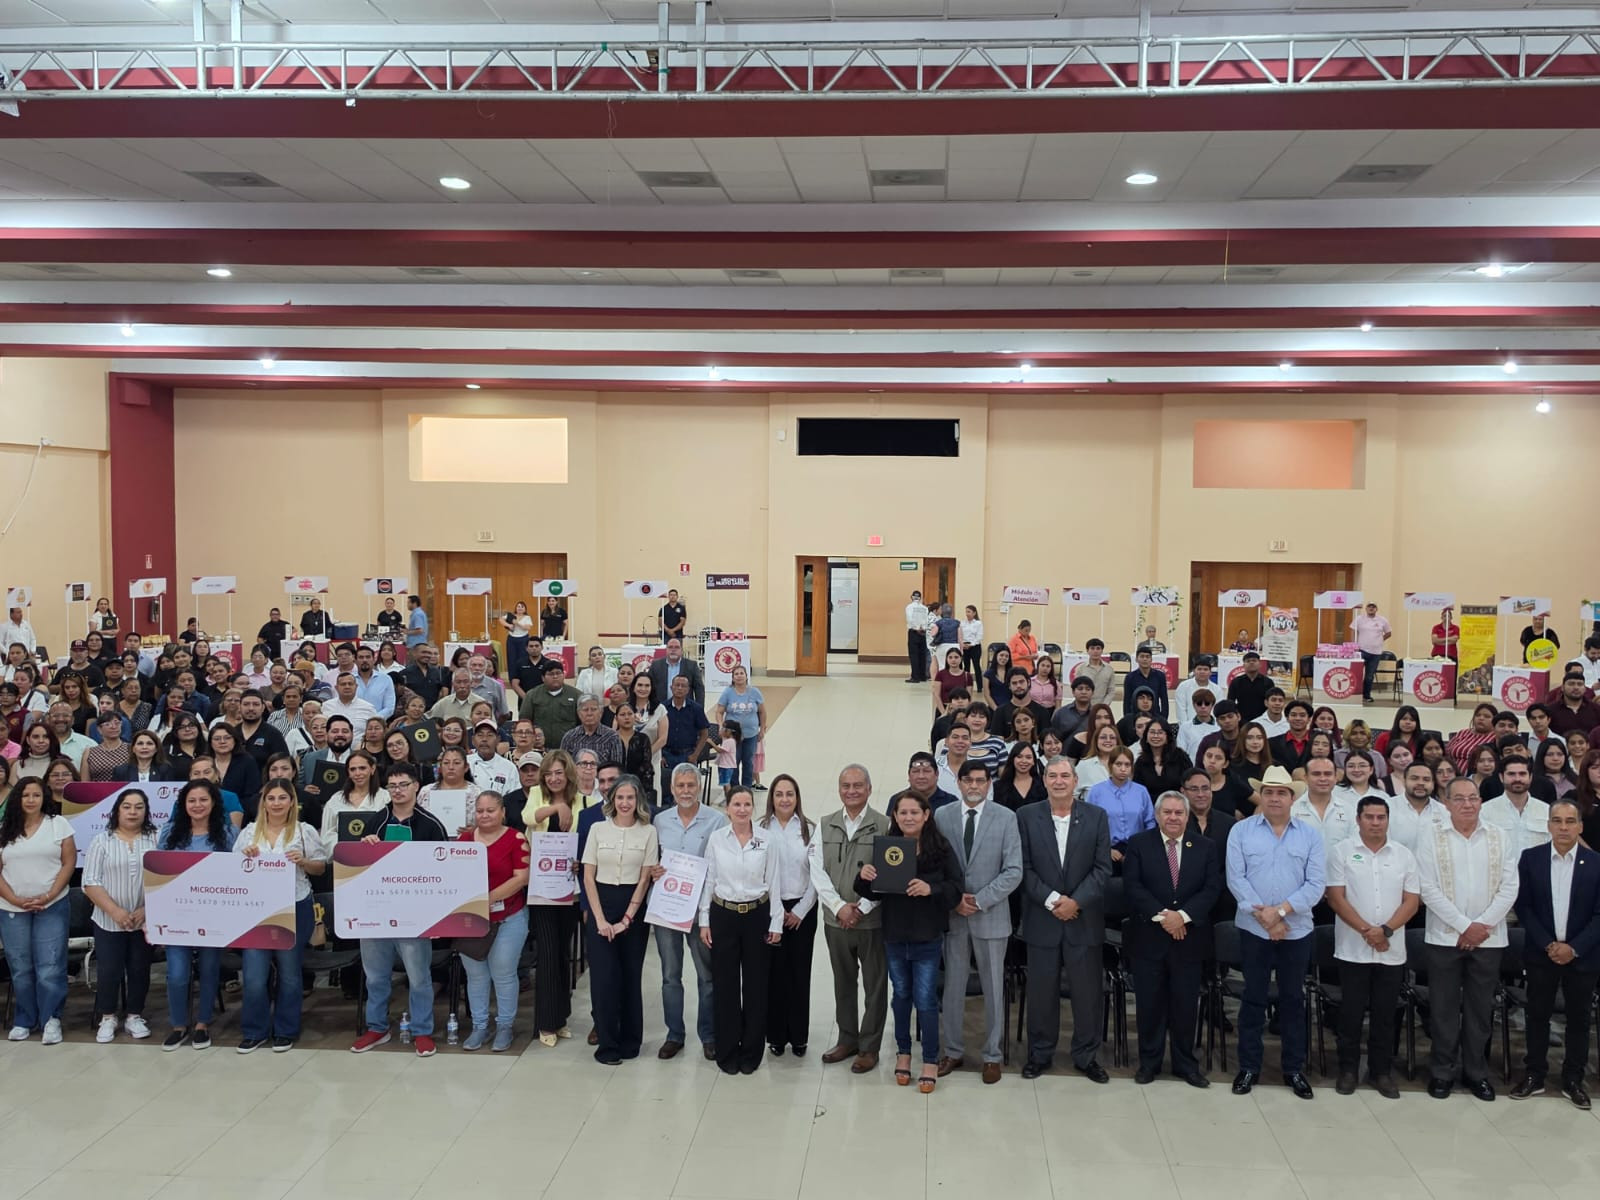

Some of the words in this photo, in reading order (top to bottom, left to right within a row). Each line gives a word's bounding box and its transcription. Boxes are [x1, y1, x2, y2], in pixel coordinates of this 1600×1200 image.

[450, 847, 478, 856] Fondo
[258, 859, 286, 868] Fondo
[381, 875, 442, 884] MICROCRÉDITO
[190, 885, 249, 895] MICROCRÉDITO
